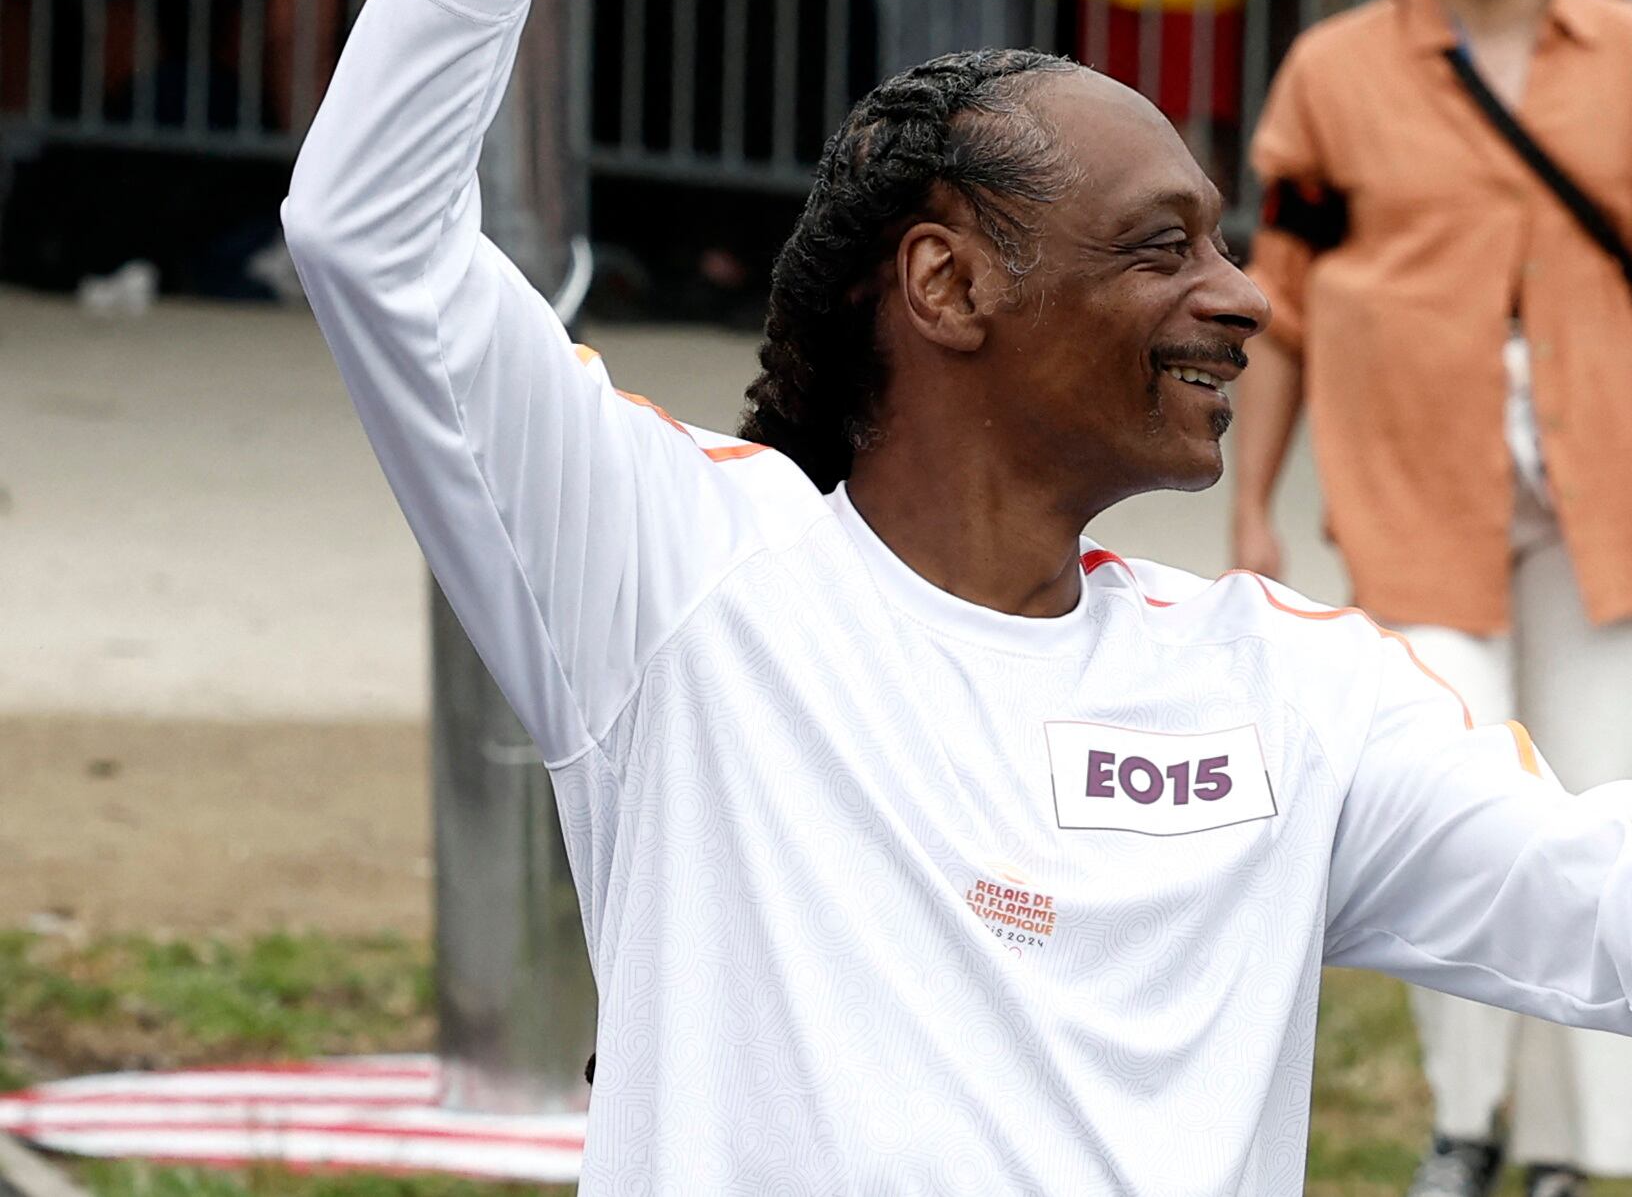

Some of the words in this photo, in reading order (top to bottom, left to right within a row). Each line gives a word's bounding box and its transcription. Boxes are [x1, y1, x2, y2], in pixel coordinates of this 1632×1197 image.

[966, 890, 985, 904] LA
[989, 897, 1057, 925] FLAMME
[976, 879, 1030, 904] RELAIS
[1033, 894, 1054, 910] DE
[1007, 932, 1045, 948] 2024
